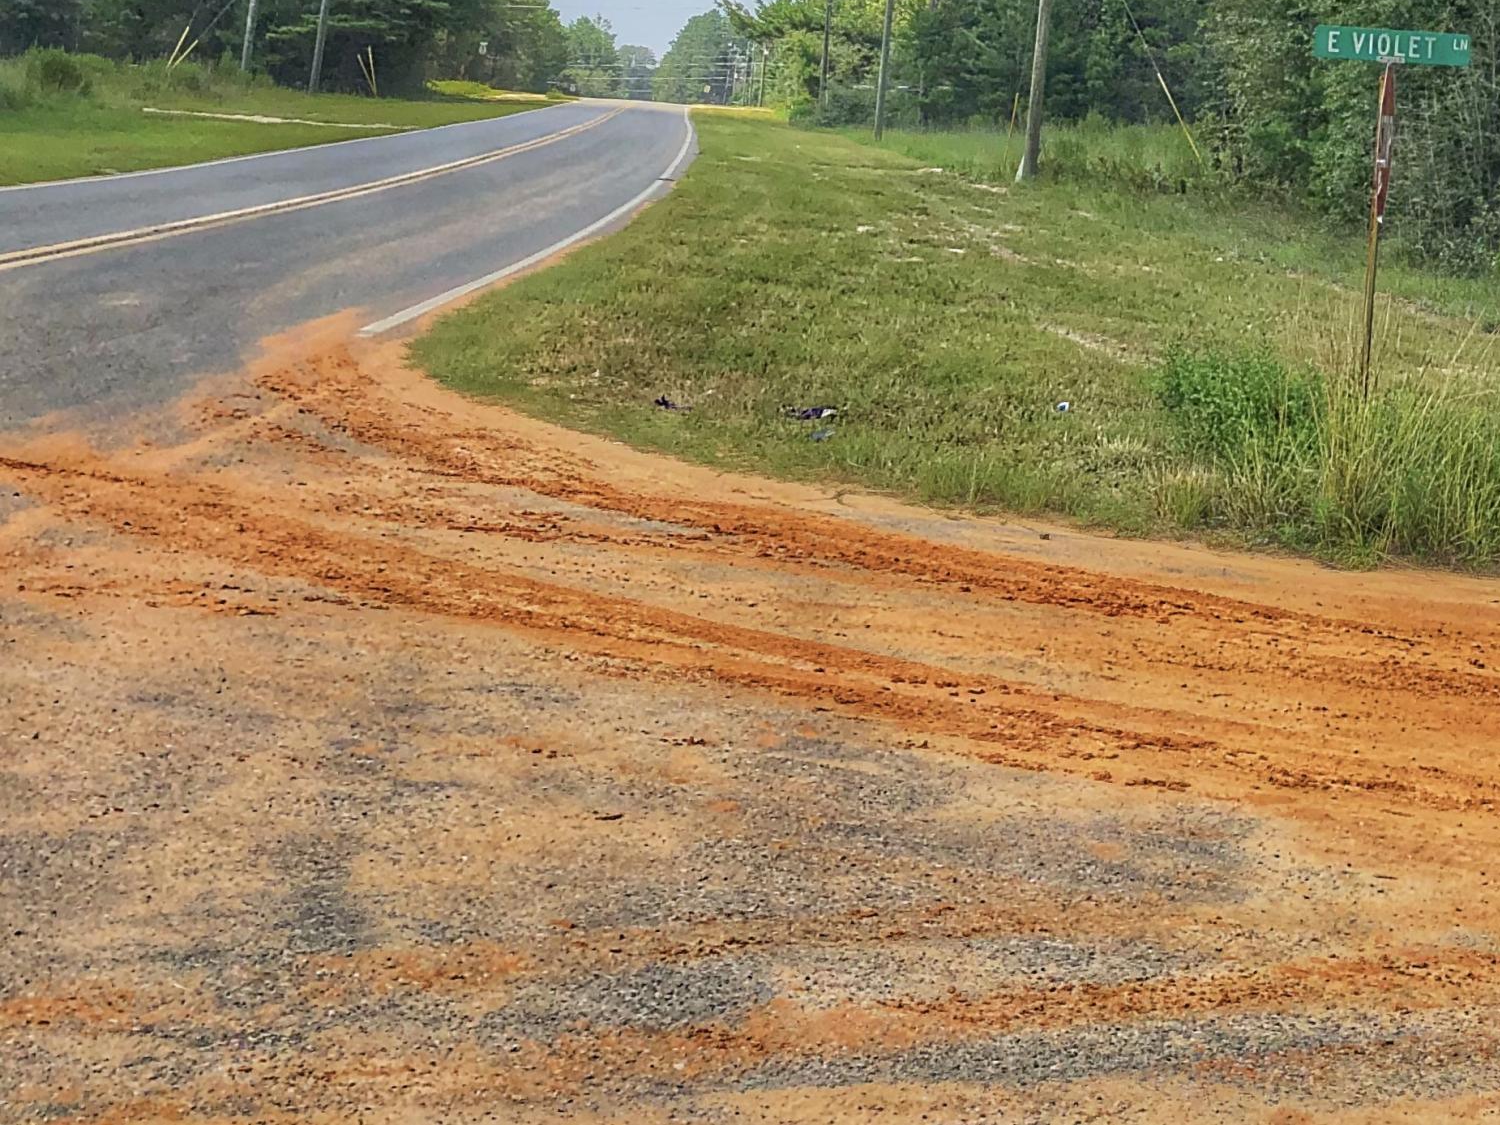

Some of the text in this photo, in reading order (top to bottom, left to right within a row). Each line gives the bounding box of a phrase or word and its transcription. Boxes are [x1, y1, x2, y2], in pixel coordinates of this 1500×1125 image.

[1328, 31, 1468, 59] E VIOLET LN
